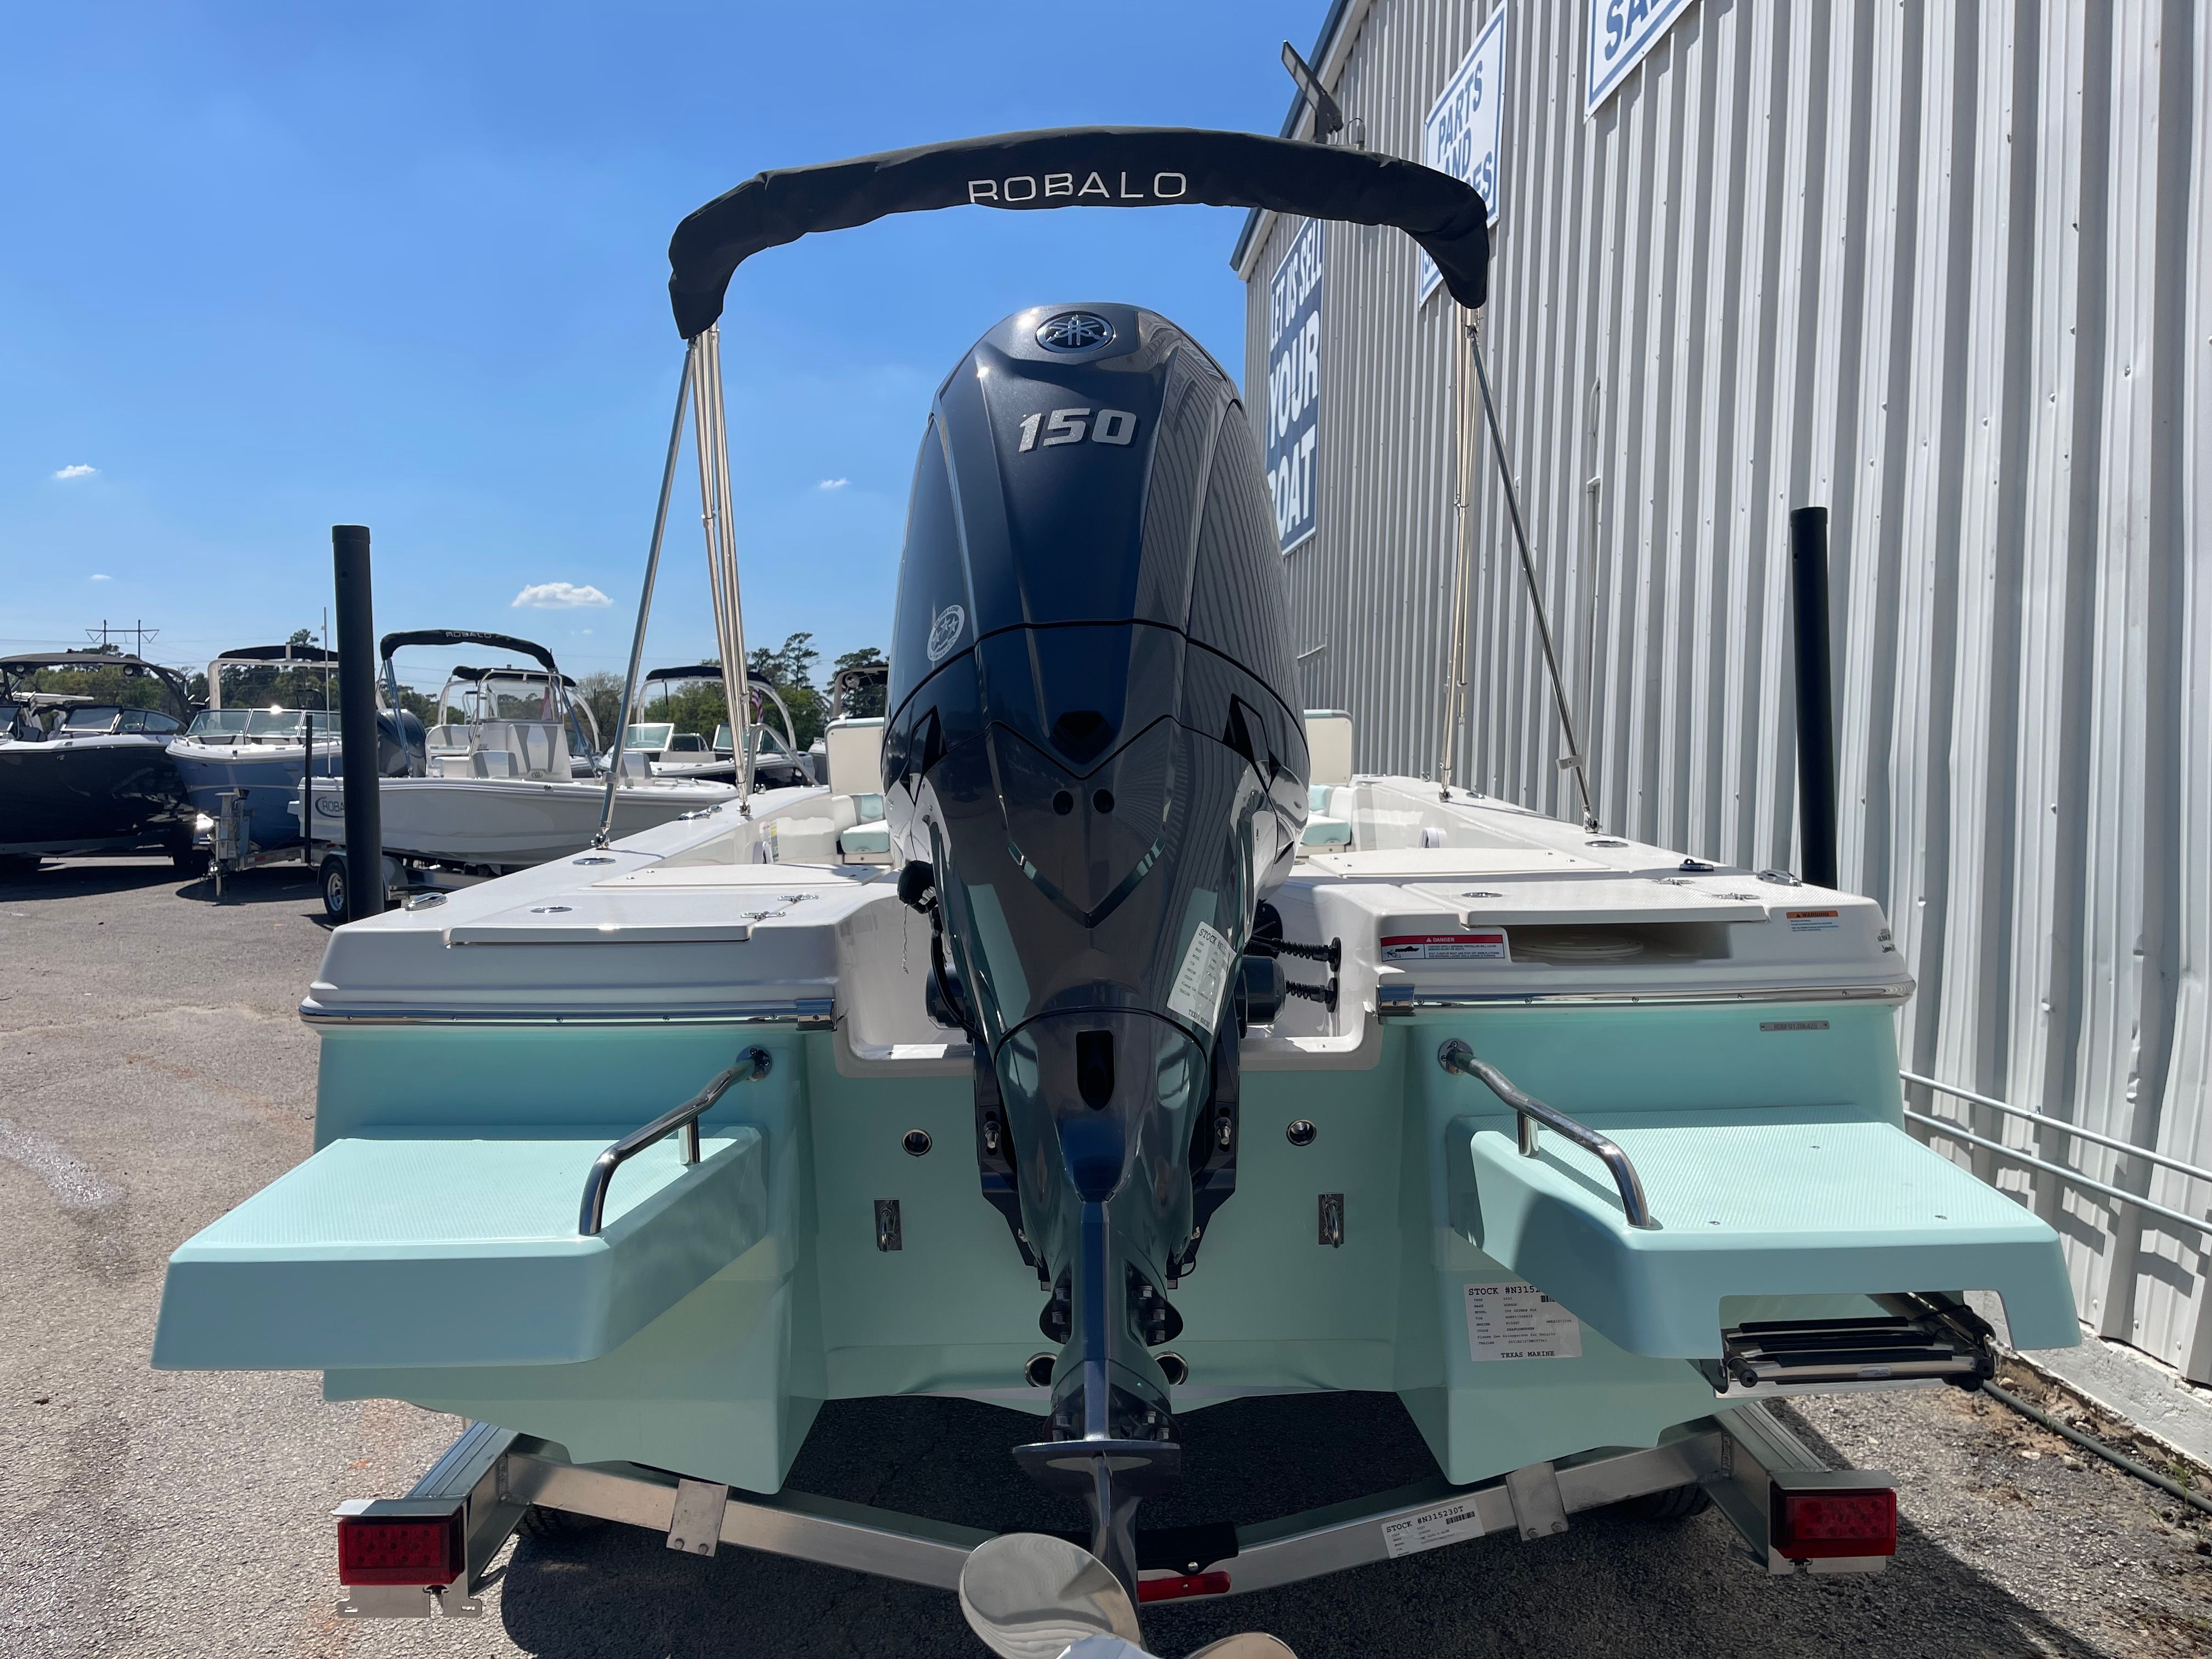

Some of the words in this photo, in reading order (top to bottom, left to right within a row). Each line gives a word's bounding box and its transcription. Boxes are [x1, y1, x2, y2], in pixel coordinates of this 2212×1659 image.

[1605, 0, 1660, 61] SA
[1437, 60, 1483, 165] PARTS
[968, 172, 1186, 203] ROBALO
[1271, 275, 1285, 352] LET
[1286, 252, 1298, 328] US
[1299, 219, 1322, 306] SELL
[1269, 311, 1319, 449] YOUR
[1019, 408, 1138, 453] 150
[1199, 928, 1217, 945] STOCK
[1386, 1521, 1413, 1533] STOCK
[1417, 1506, 1464, 1525] #N315230T
